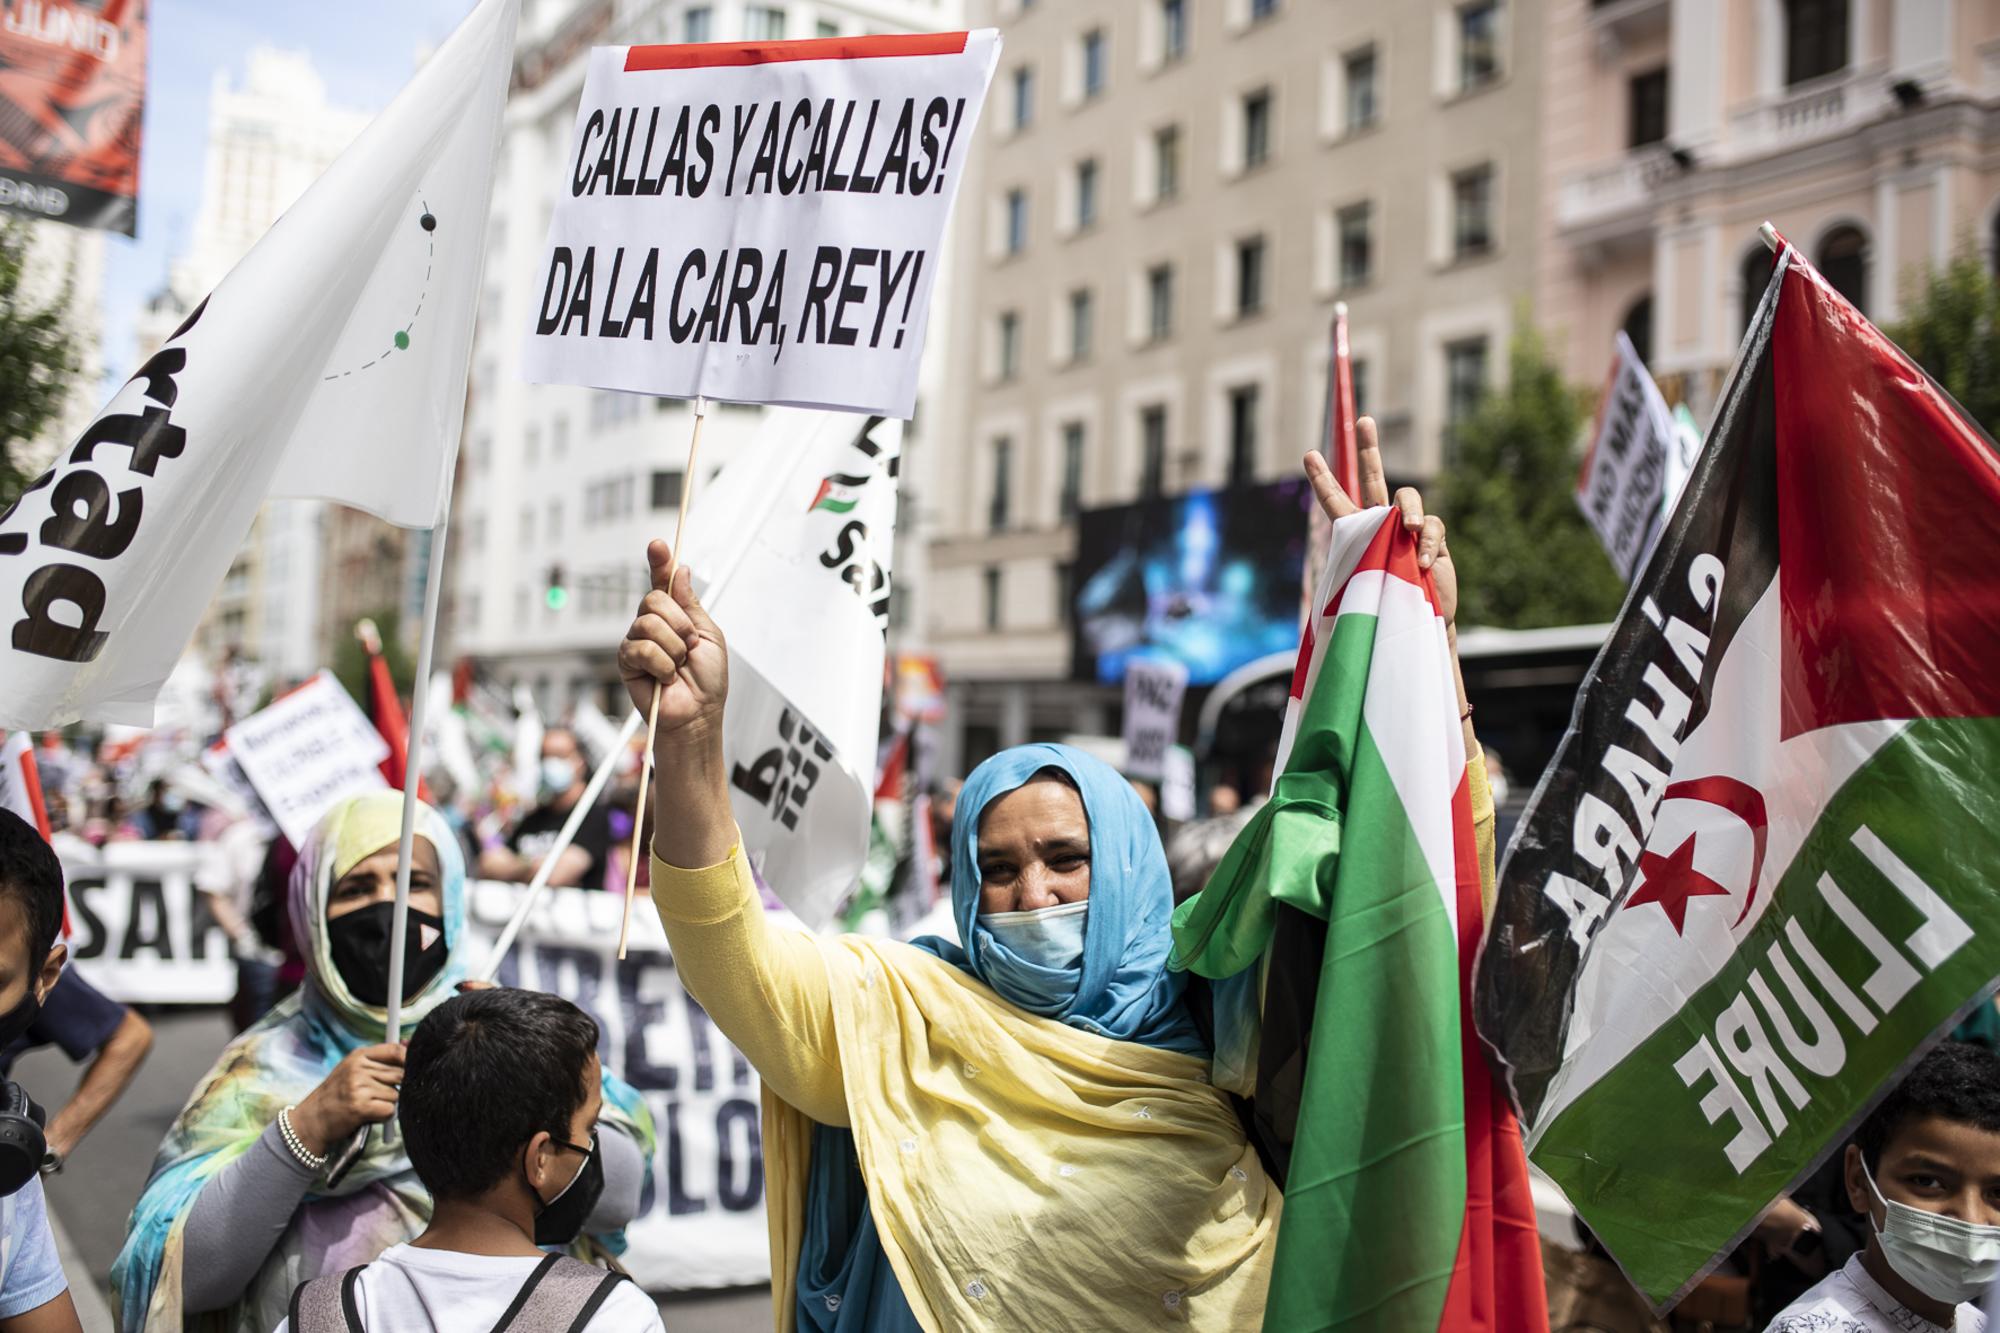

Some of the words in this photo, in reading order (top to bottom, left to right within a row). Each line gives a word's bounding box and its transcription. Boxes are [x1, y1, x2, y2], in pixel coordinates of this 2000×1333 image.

[572, 104, 720, 198] CALLAS
[724, 103, 759, 197] Y
[745, 96, 966, 197] ACALLAS!
[536, 246, 596, 337] DA
[599, 246, 660, 341] LA
[668, 247, 788, 365] CARA,
[796, 245, 926, 350] REY!
